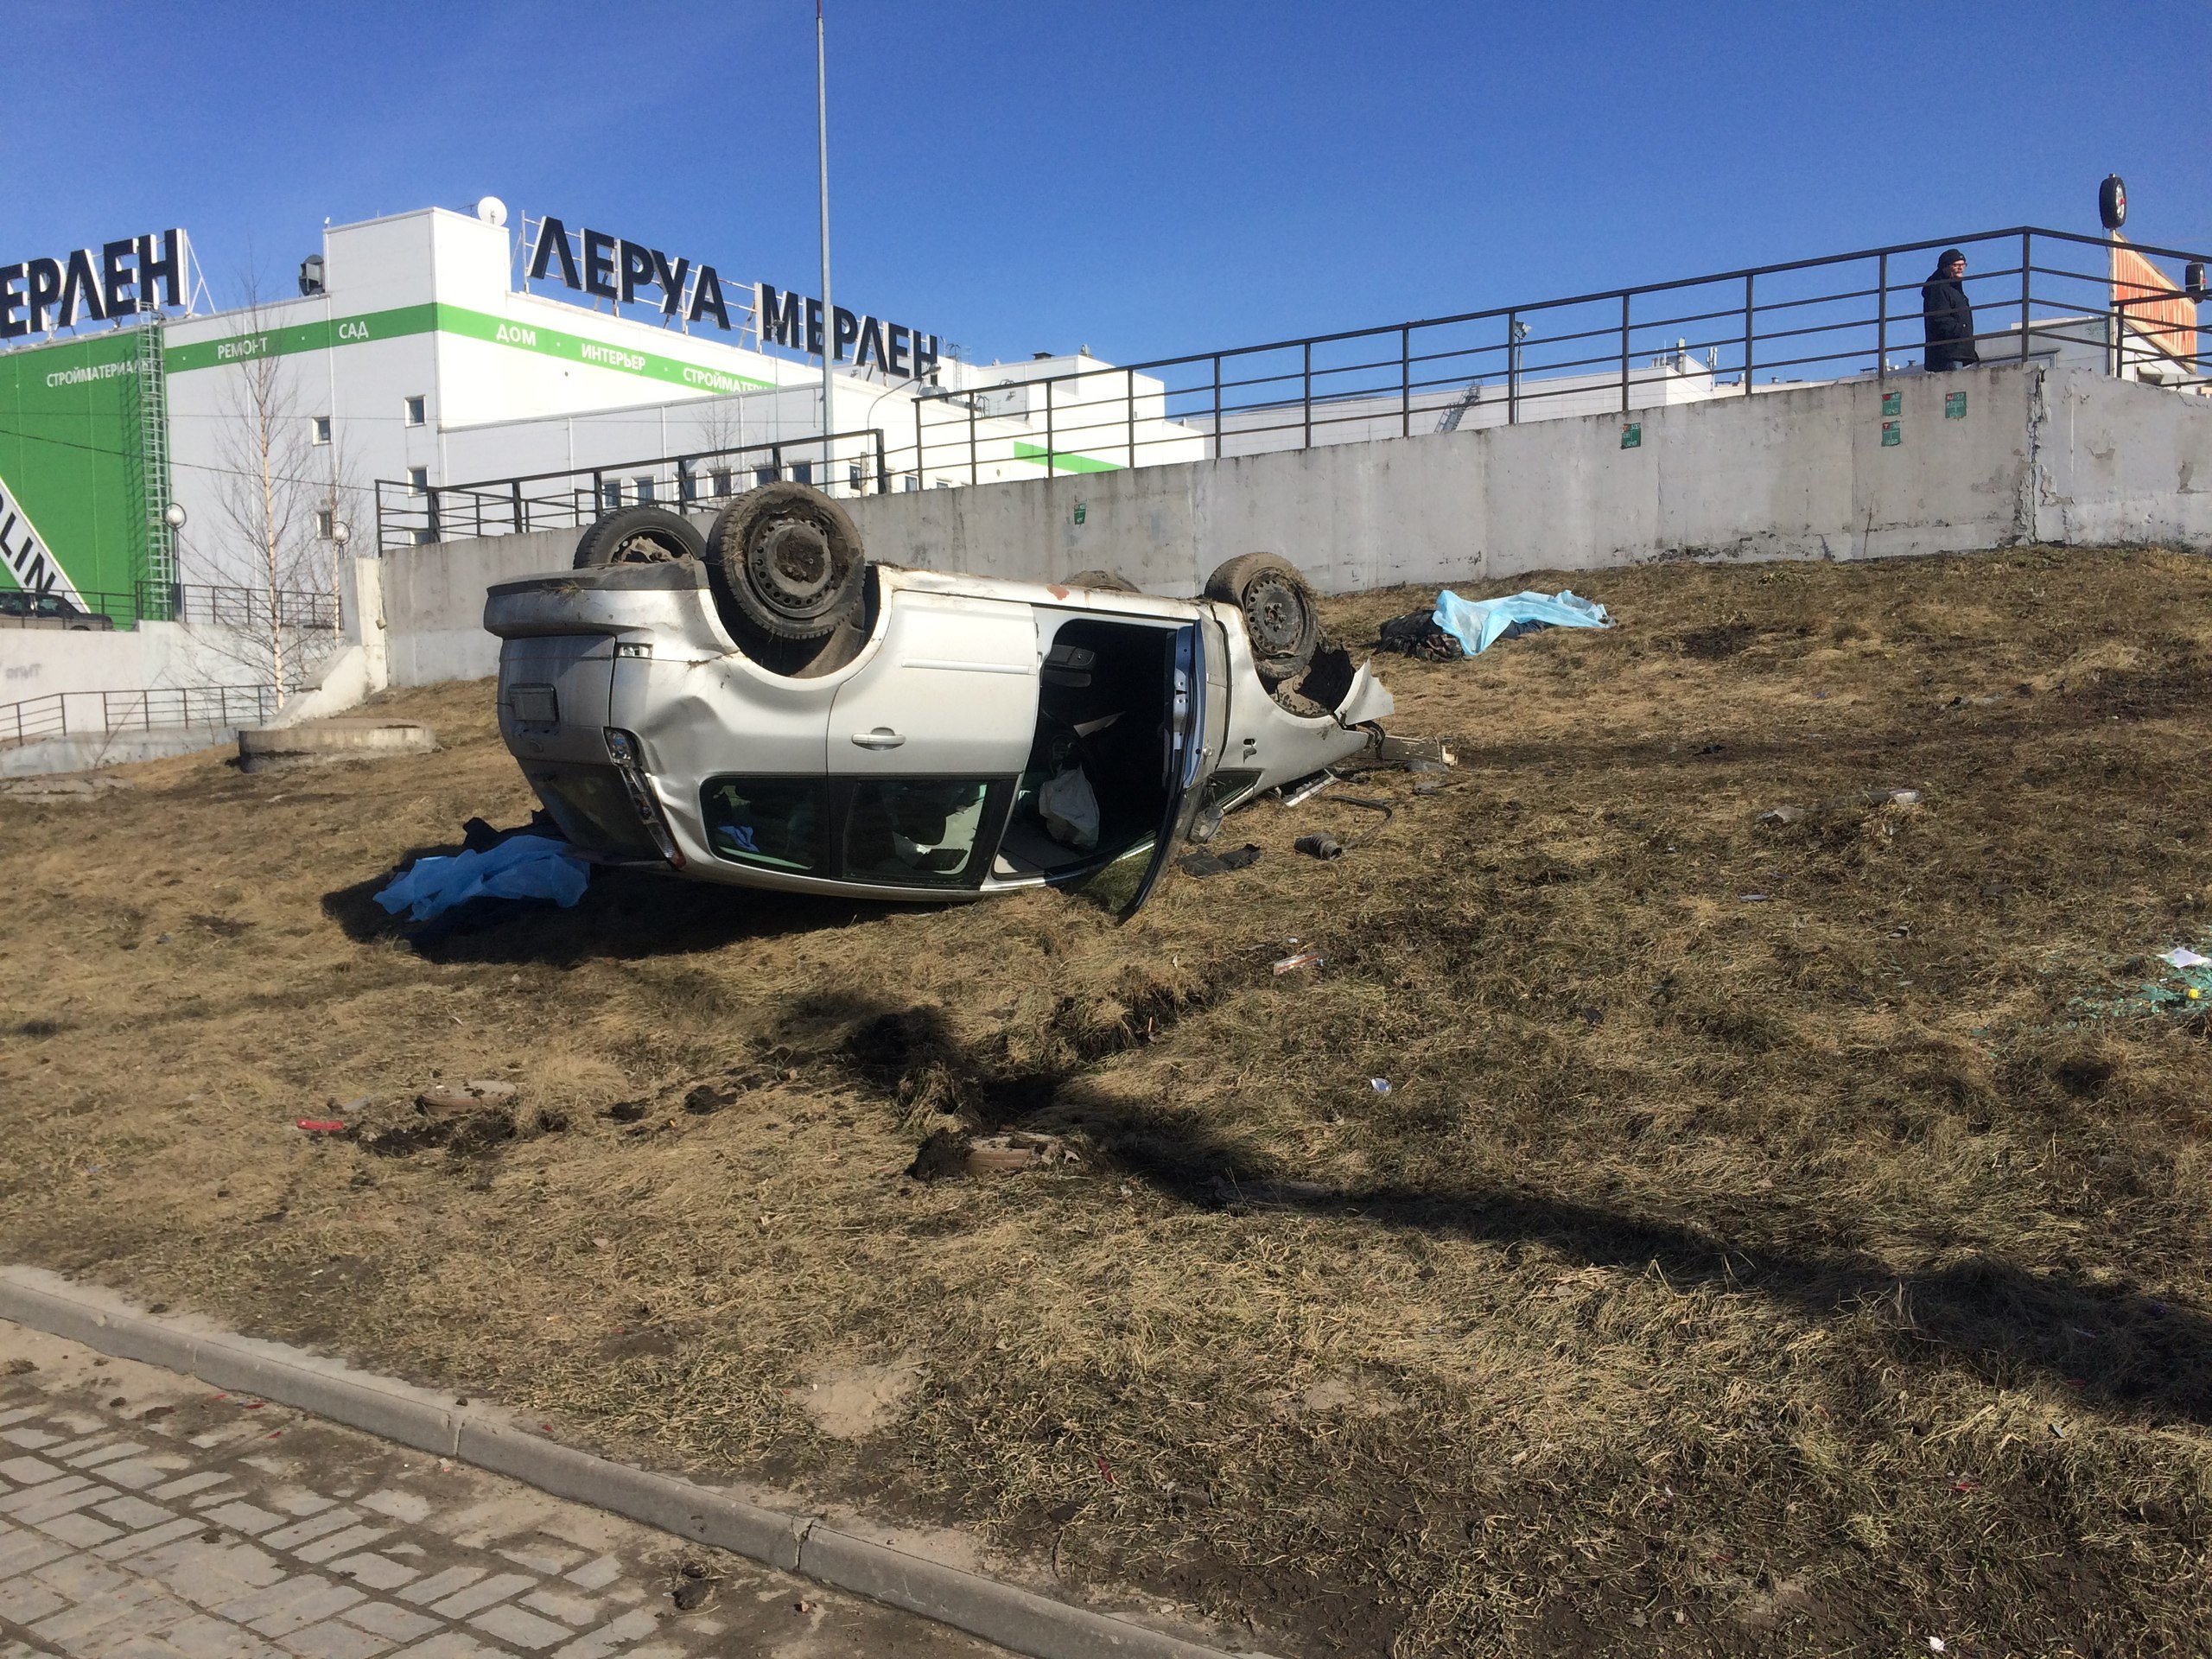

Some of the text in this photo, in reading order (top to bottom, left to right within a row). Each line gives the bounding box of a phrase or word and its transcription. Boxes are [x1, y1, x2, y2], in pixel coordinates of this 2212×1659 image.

[0, 228, 185, 338] ЕРЛЕН
[528, 215, 938, 386] ЛЕРУА МЕРЛЕН
[218, 321, 369, 359] РЕМОНТ САД
[496, 323, 767, 393] ДОМ ИНТЕРЬЕР СТРОЙМАТЕ
[0, 493, 56, 594] LIN
